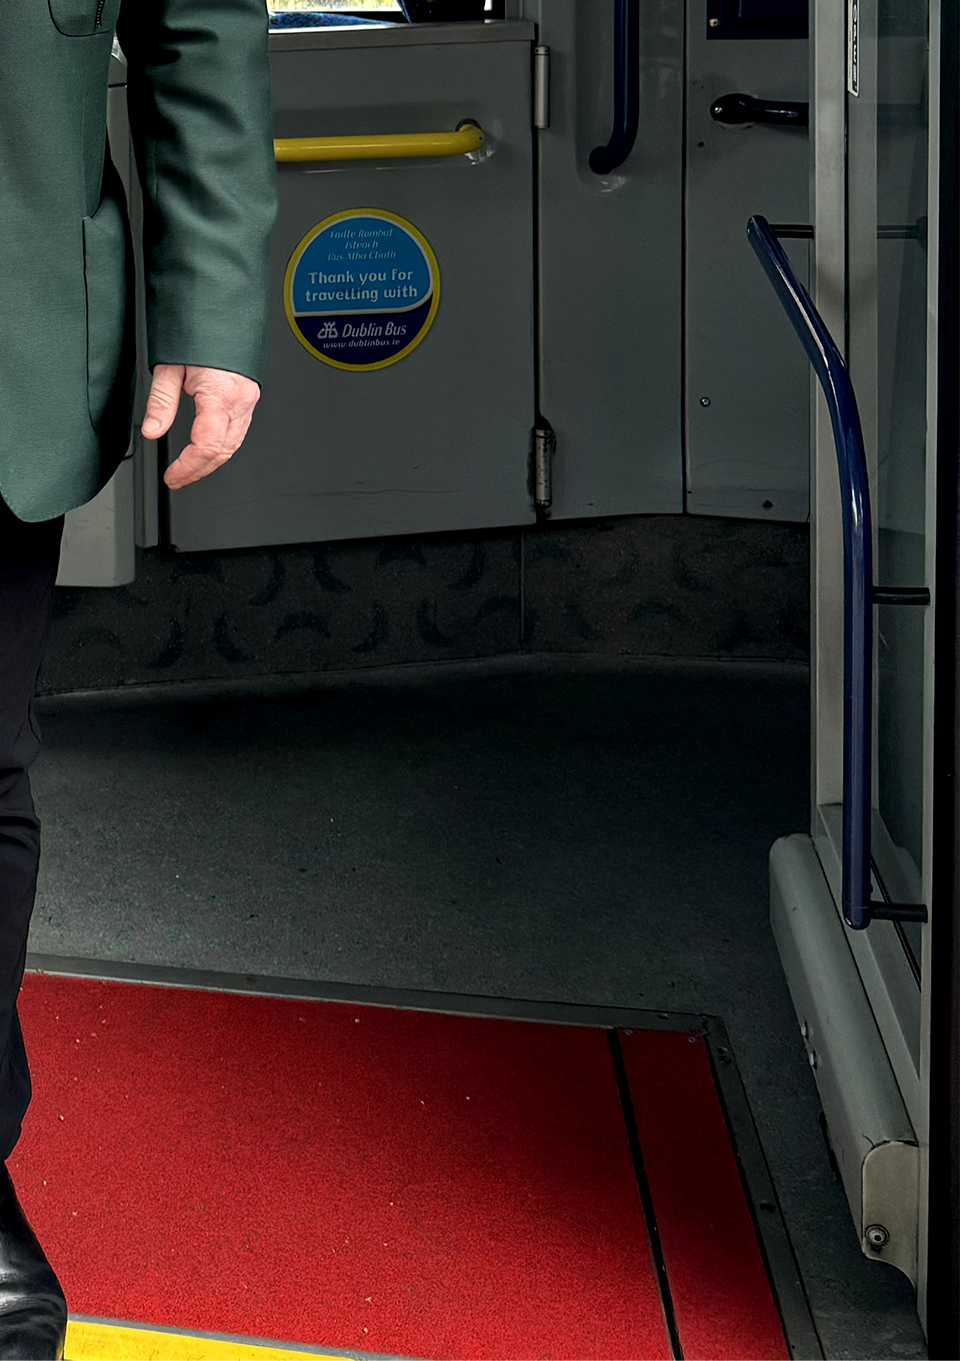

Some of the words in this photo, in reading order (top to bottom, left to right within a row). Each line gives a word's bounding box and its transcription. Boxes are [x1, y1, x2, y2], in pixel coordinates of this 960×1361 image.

[308, 271, 354, 285] Thank
[359, 272, 387, 286] you
[391, 268, 414, 281] for
[305, 287, 379, 302] travelling
[383, 285, 418, 299] with
[342, 322, 382, 338] Dublin
[385, 321, 407, 336] Bus
[323, 338, 401, 349] www.dublinbus.ie
